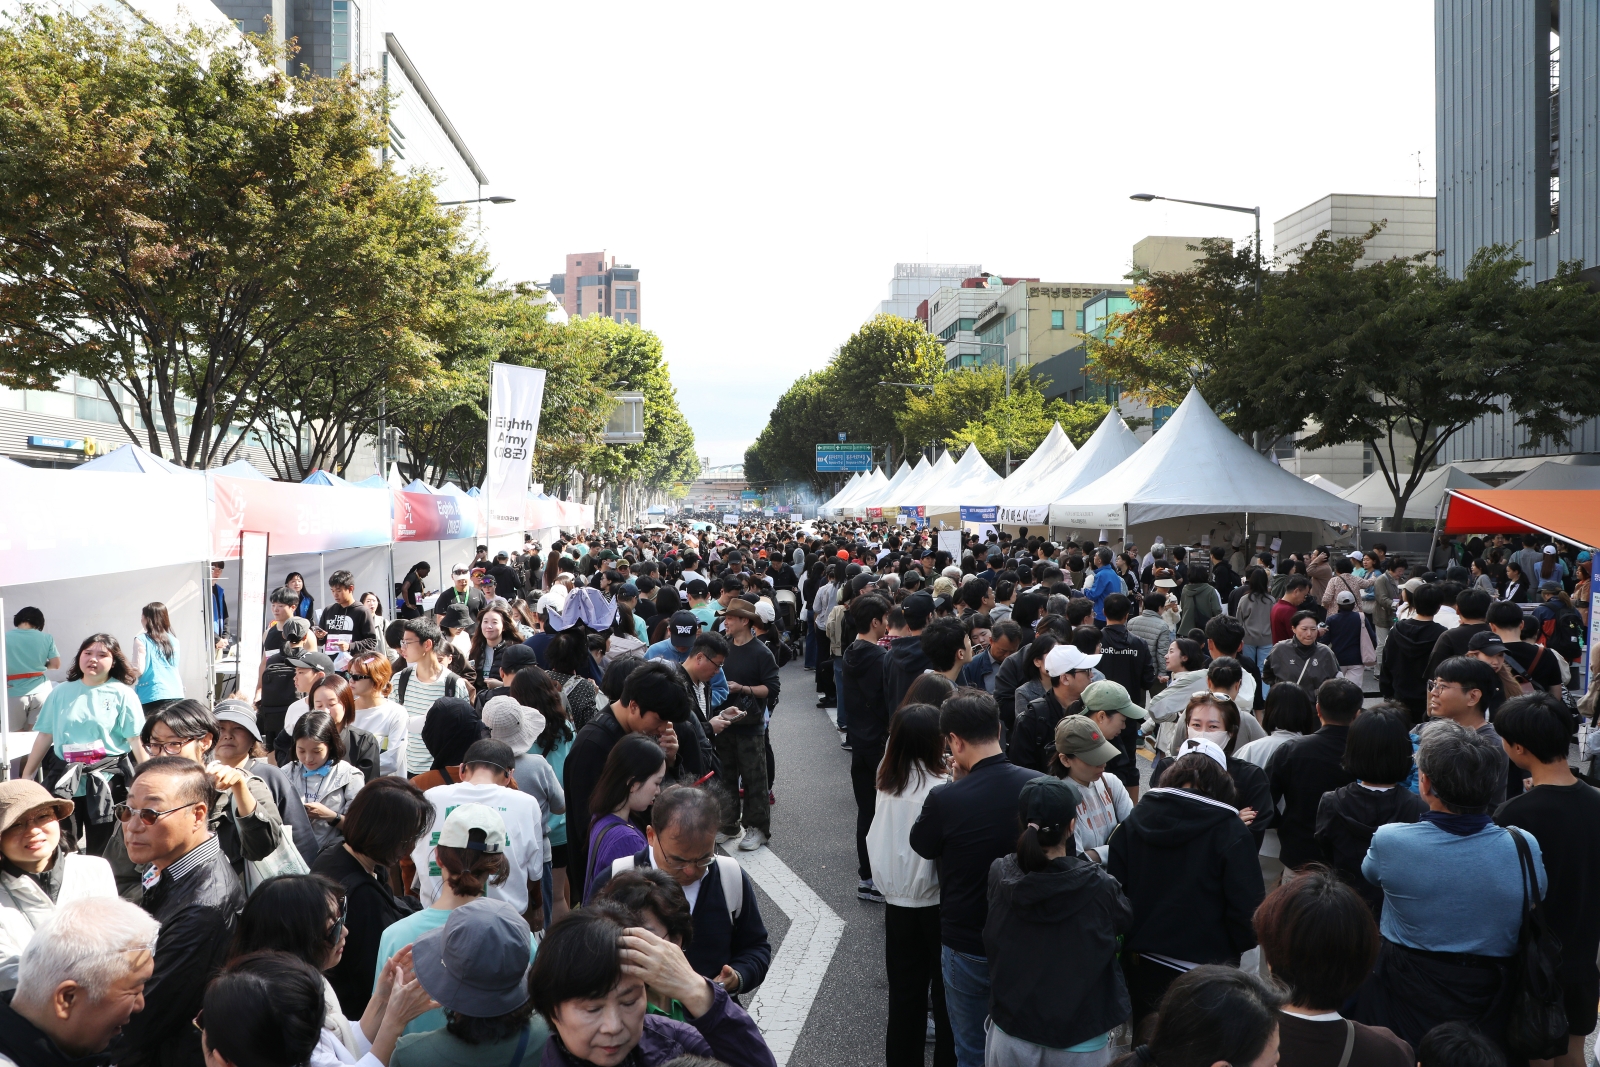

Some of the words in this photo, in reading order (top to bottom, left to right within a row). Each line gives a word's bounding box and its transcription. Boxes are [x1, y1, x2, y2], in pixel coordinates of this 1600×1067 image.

[1029, 286, 1112, 299] 한국냉동공조
[495, 416, 533, 432] Eighth
[497, 432, 528, 448] Army
[675, 625, 694, 635] PXG
[1100, 647, 1138, 657] ooRunning
